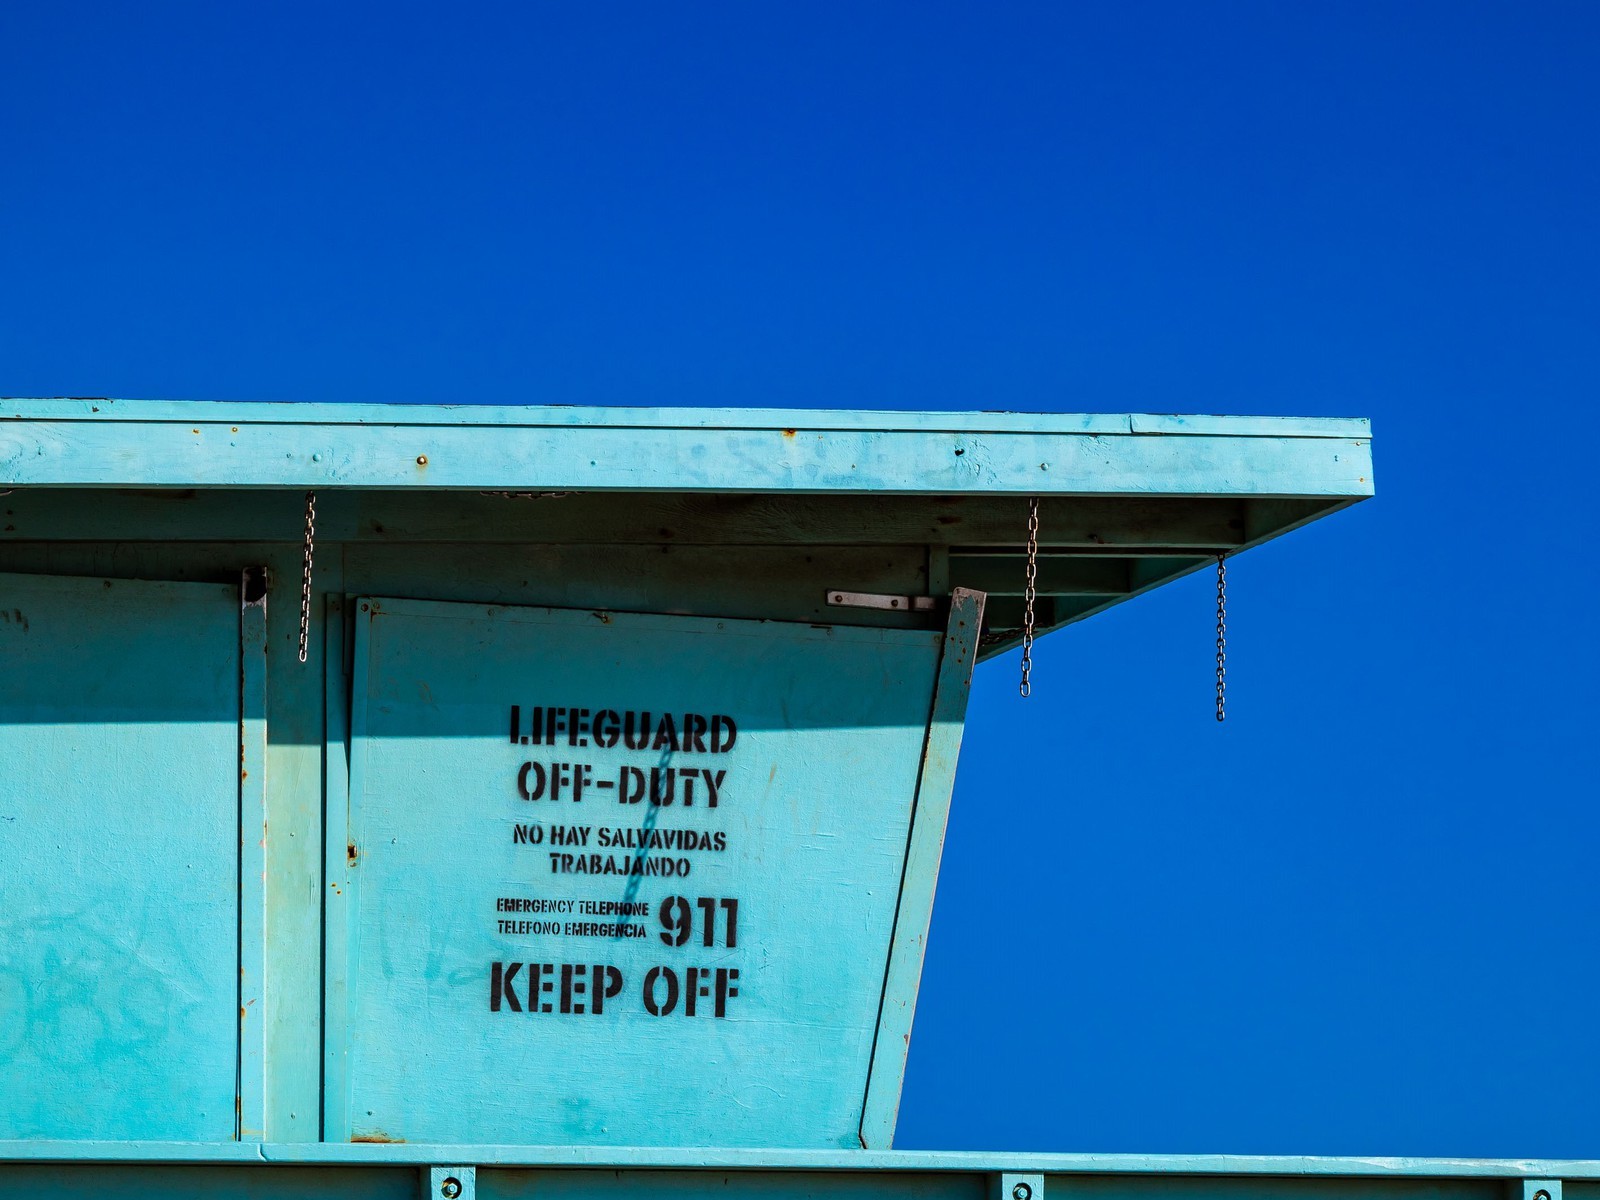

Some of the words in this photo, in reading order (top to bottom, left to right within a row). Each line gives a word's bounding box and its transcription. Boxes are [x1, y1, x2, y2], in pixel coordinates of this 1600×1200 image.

[509, 705, 738, 753] LIFEGUARD
[517, 761, 727, 808] OFF-DUTY
[513, 824, 544, 845] NO
[550, 826, 592, 847] HAY
[597, 828, 727, 851] SALVAVIDAS
[550, 853, 691, 877] TRABAJANDO
[496, 897, 575, 914] EMERGENCY
[578, 900, 649, 917] TELEPHONE
[658, 895, 739, 948] 911
[497, 919, 561, 936] TELEFONO
[564, 922, 647, 938] EMERGENCIA
[490, 961, 623, 1015] KEEP
[642, 966, 740, 1018] OFF
